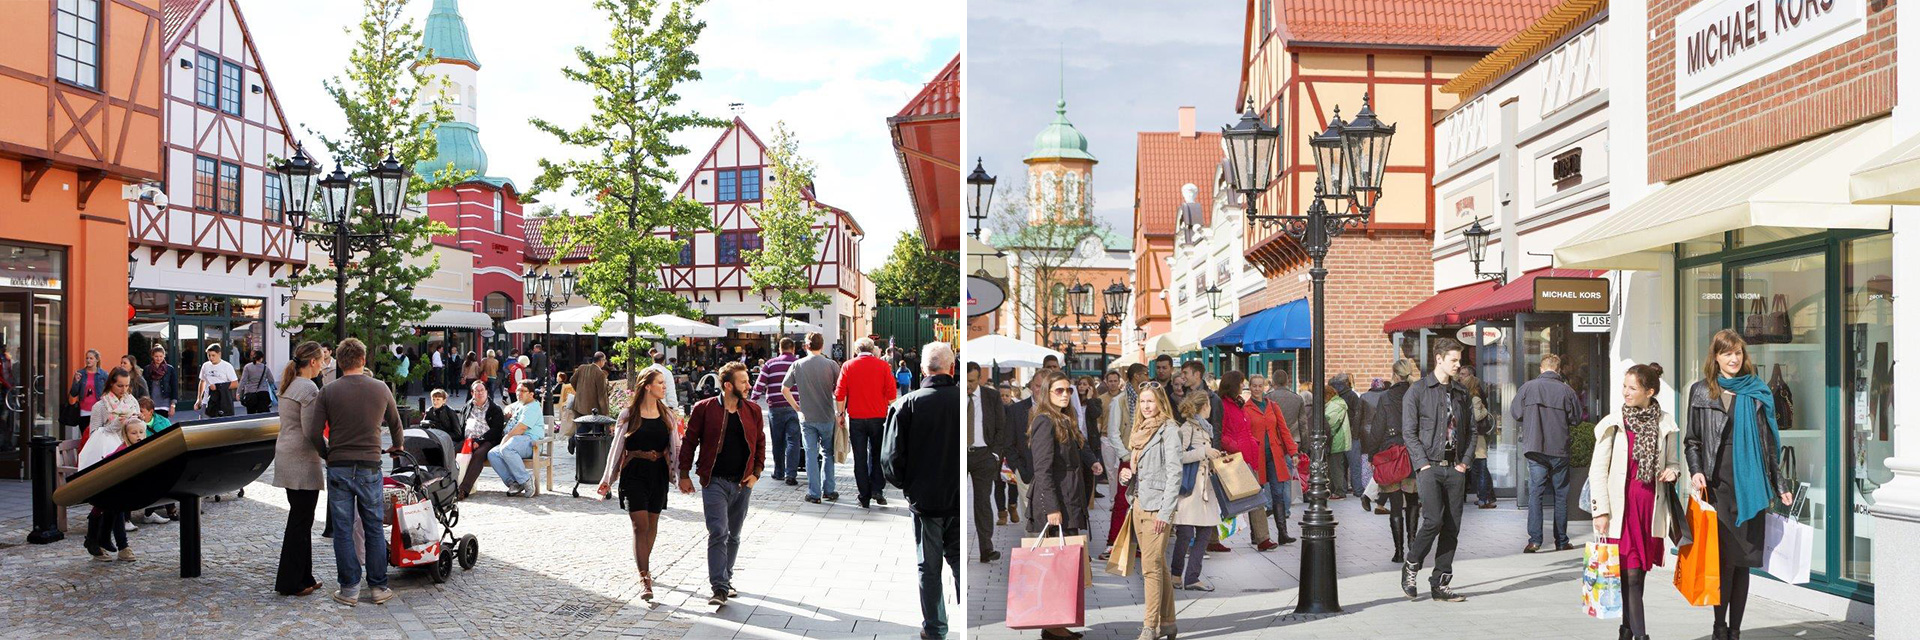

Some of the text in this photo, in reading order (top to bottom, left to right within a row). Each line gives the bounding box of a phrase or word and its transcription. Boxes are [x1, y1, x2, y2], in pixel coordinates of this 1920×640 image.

[1687, 0, 1834, 75] MICHAEL KOR
[1541, 290, 1602, 299] MICHAEL KORS
[181, 301, 219, 312] ESPRIT
